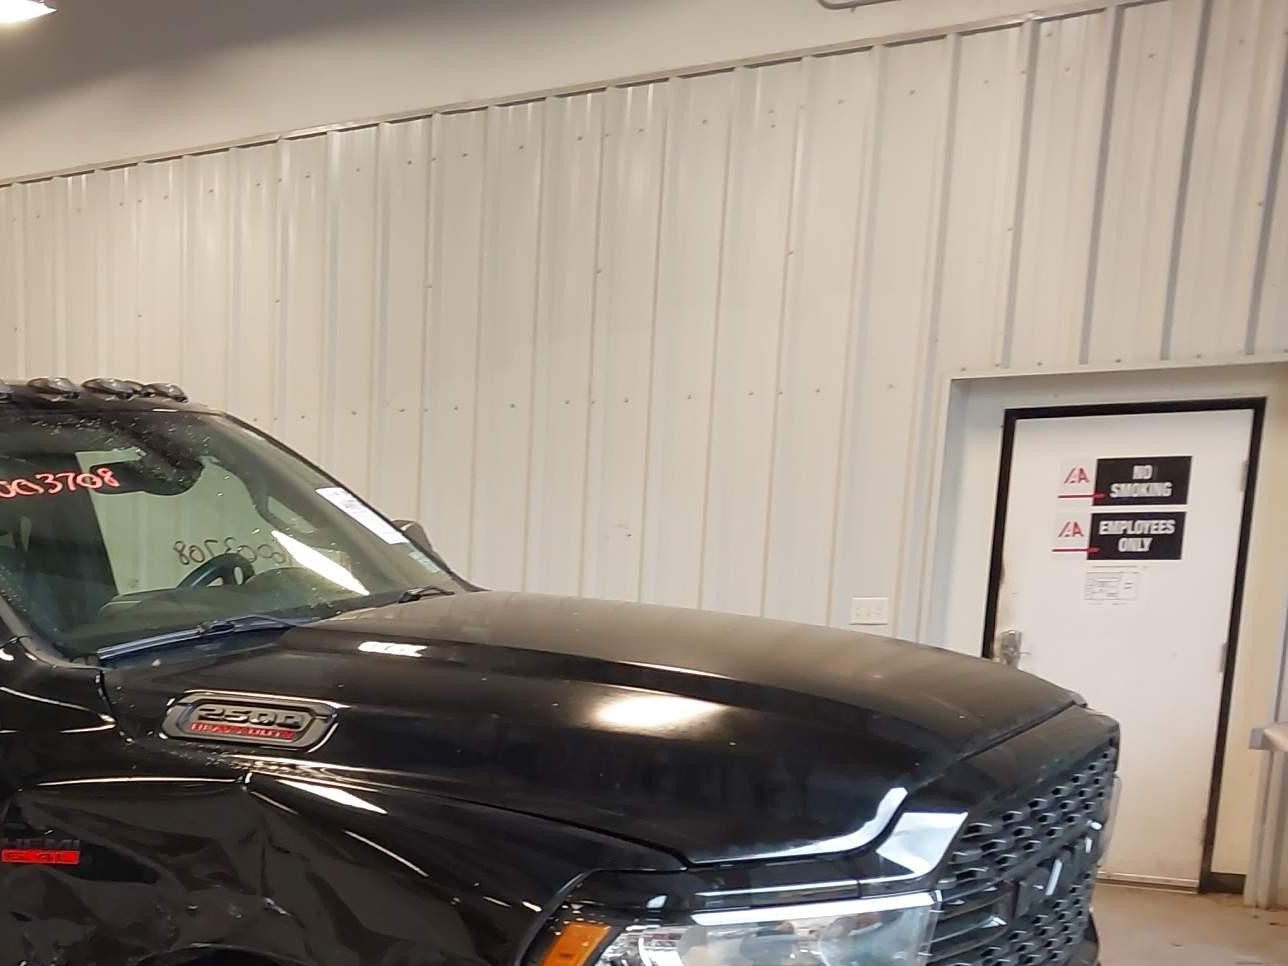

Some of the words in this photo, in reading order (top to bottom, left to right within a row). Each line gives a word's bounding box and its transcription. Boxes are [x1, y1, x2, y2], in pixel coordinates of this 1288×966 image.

[1132, 464, 1153, 480] NO
[1109, 481, 1173, 499] SMOKING
[1098, 519, 1176, 536] EMPLOYEES
[1117, 537, 1153, 553] ONLY
[198, 705, 304, 730] 2500
